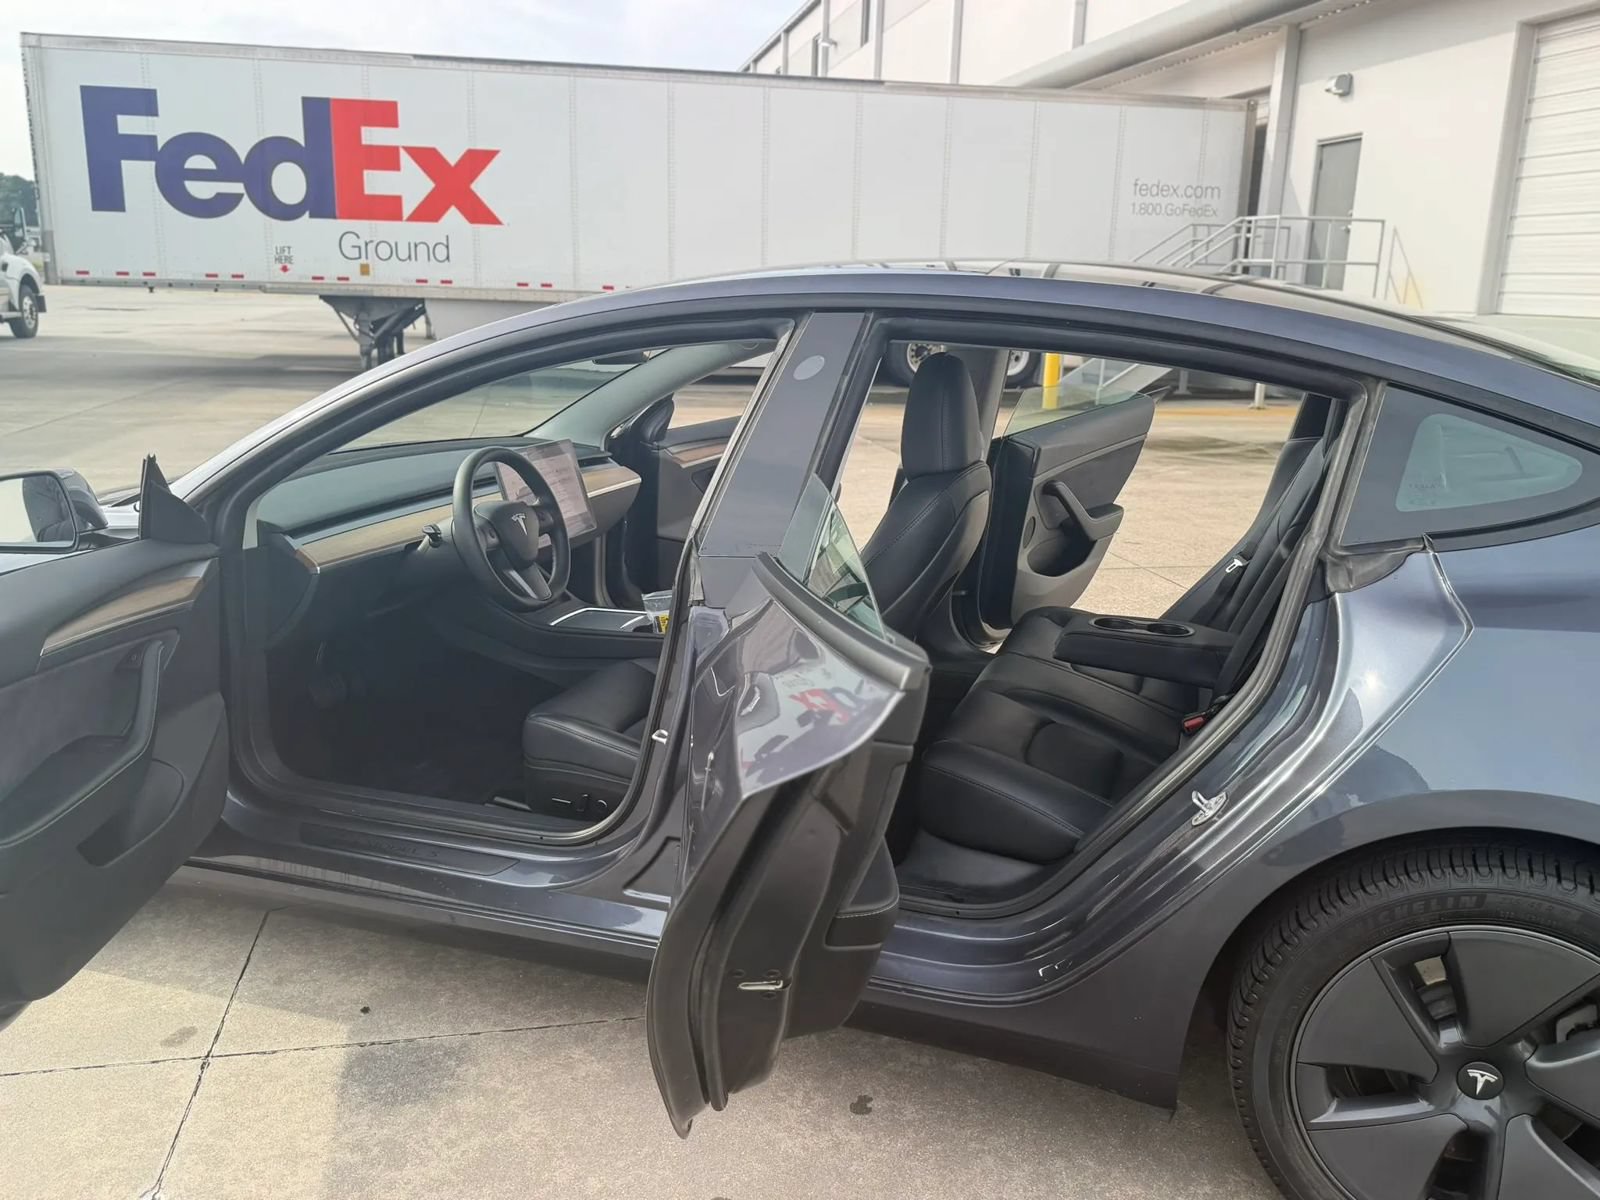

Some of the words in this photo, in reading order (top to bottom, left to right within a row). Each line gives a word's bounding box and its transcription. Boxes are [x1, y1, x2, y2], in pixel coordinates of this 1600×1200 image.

[80, 85, 505, 226] FedEx
[1133, 178, 1221, 200] fedex.com
[275, 246, 292, 255] LIFT
[338, 231, 451, 263] Ground
[274, 255, 294, 265] HERE
